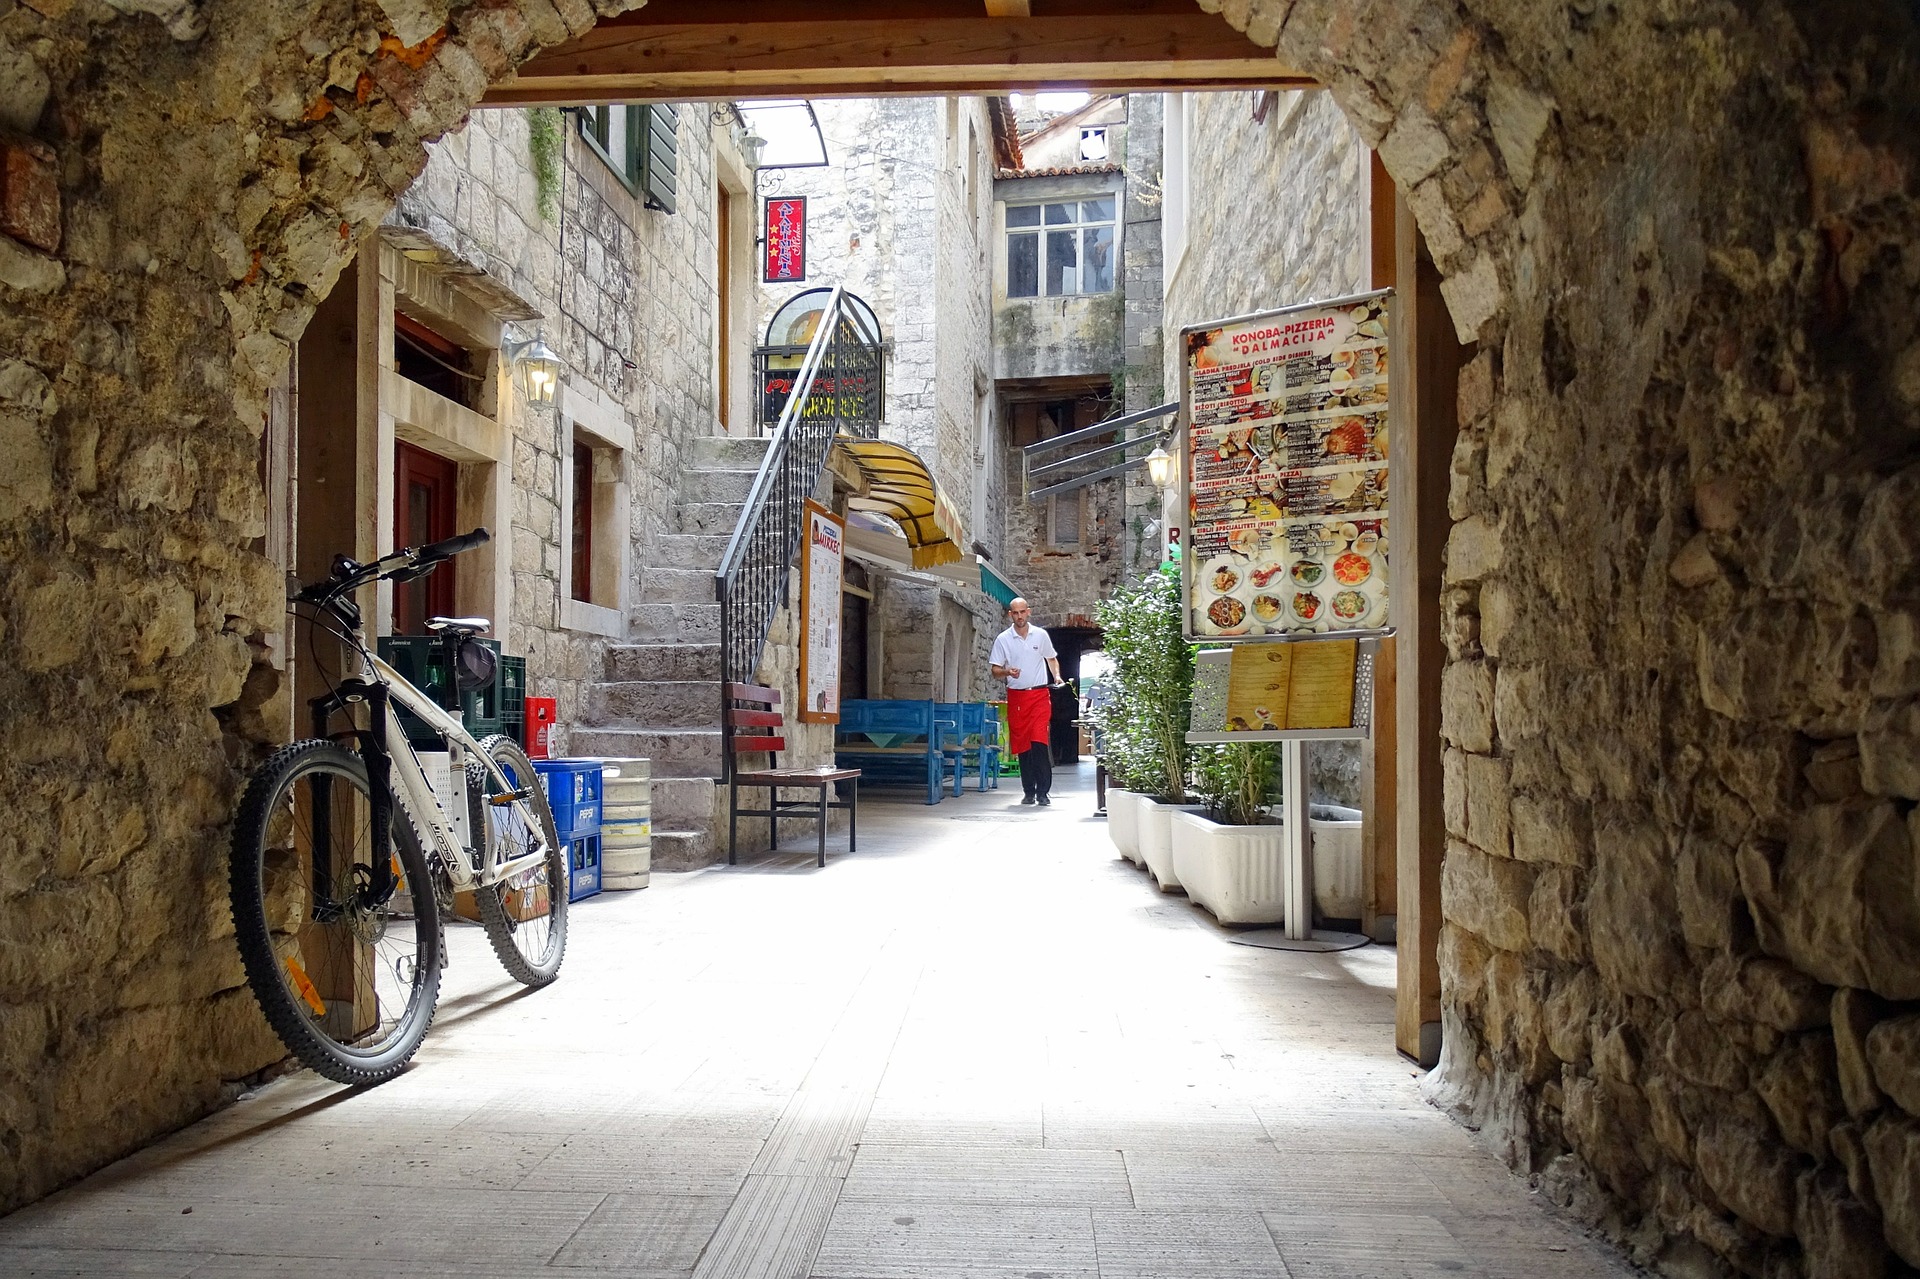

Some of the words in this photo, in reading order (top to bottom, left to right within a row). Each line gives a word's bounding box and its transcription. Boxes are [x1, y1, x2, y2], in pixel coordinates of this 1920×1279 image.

[1232, 317, 1335, 345] KONOBA-PIZZERIA
[1194, 368, 1219, 376] HLADNA
[1222, 362, 1250, 371] PREDJELA
[819, 533, 840, 555] MIRKEC
[579, 808, 594, 820] PEPSI
[578, 874, 593, 887] PEPSI
